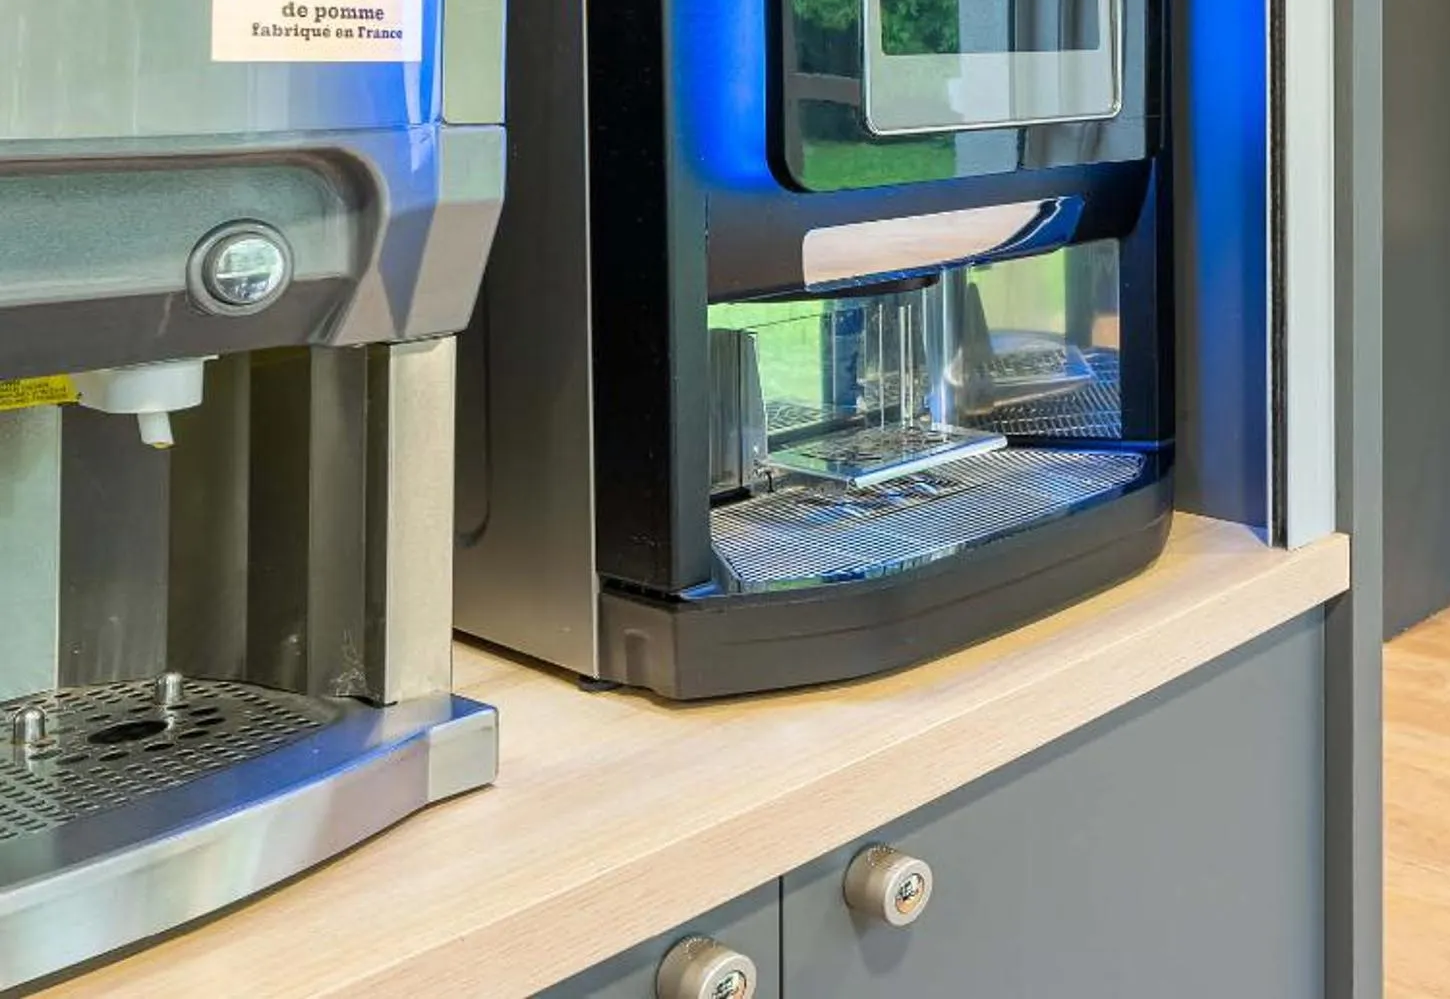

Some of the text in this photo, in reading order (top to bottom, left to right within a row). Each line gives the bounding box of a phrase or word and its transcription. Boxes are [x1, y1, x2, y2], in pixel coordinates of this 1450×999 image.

[281, 1, 386, 23] de pomme
[335, 27, 354, 39] en
[357, 25, 404, 40] France
